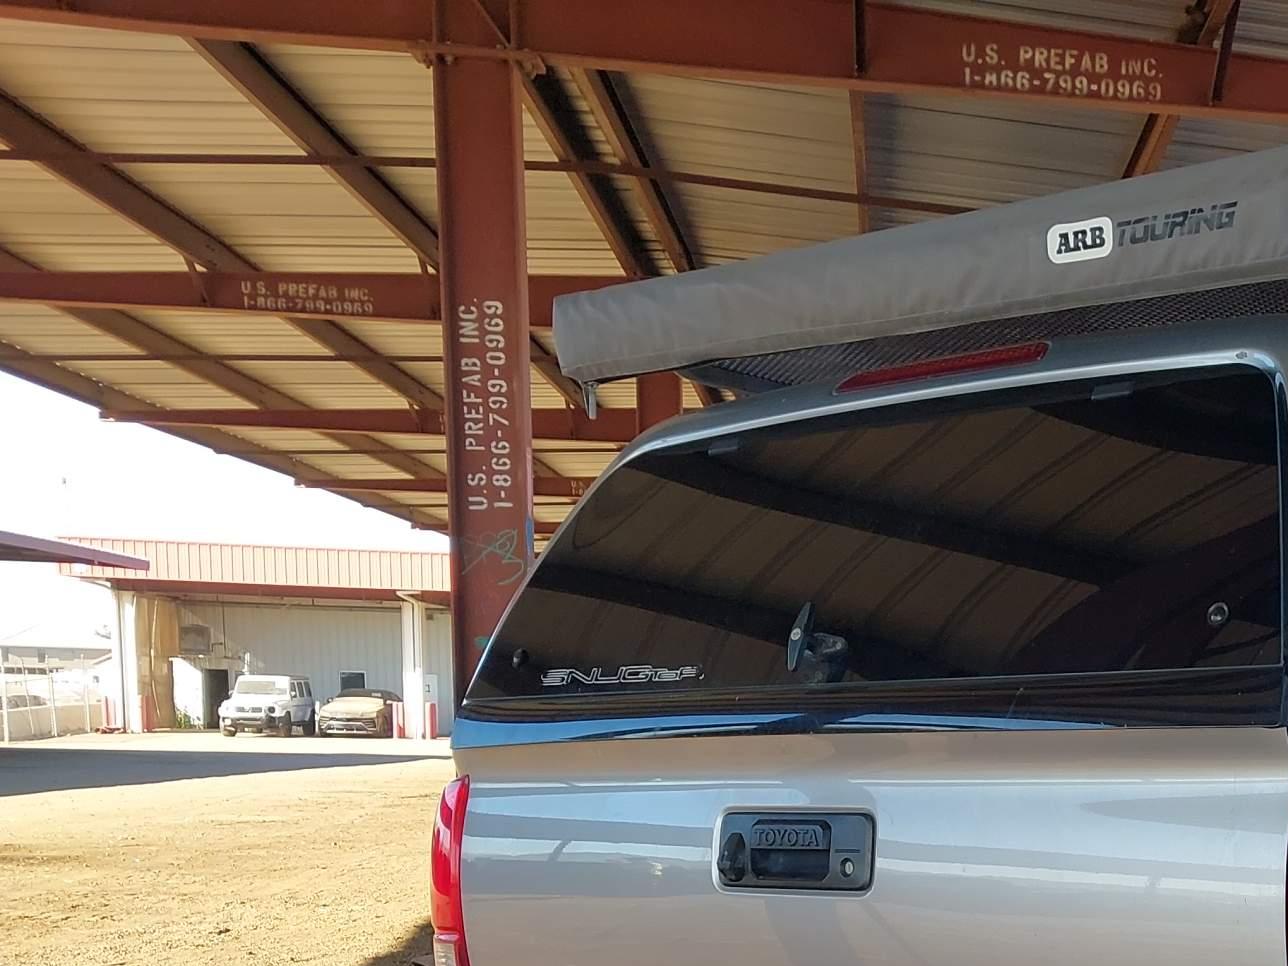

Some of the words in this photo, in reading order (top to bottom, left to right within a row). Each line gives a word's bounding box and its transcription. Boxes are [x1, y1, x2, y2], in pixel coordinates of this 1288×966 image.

[962, 42, 1006, 66] U.S.
[1019, 46, 1109, 73] PREFAB
[1121, 57, 1164, 79] INC.
[1056, 226, 1106, 255] ARB
[1116, 200, 1238, 247] TOURING
[278, 282, 338, 300] PREFAB
[344, 287, 374, 302] INC.
[457, 297, 480, 344] INC.
[460, 356, 486, 451] PREFAB
[482, 300, 514, 508] 1-866-799-0969
[467, 464, 489, 511] U.S.
[753, 828, 821, 848] TOYOTA
